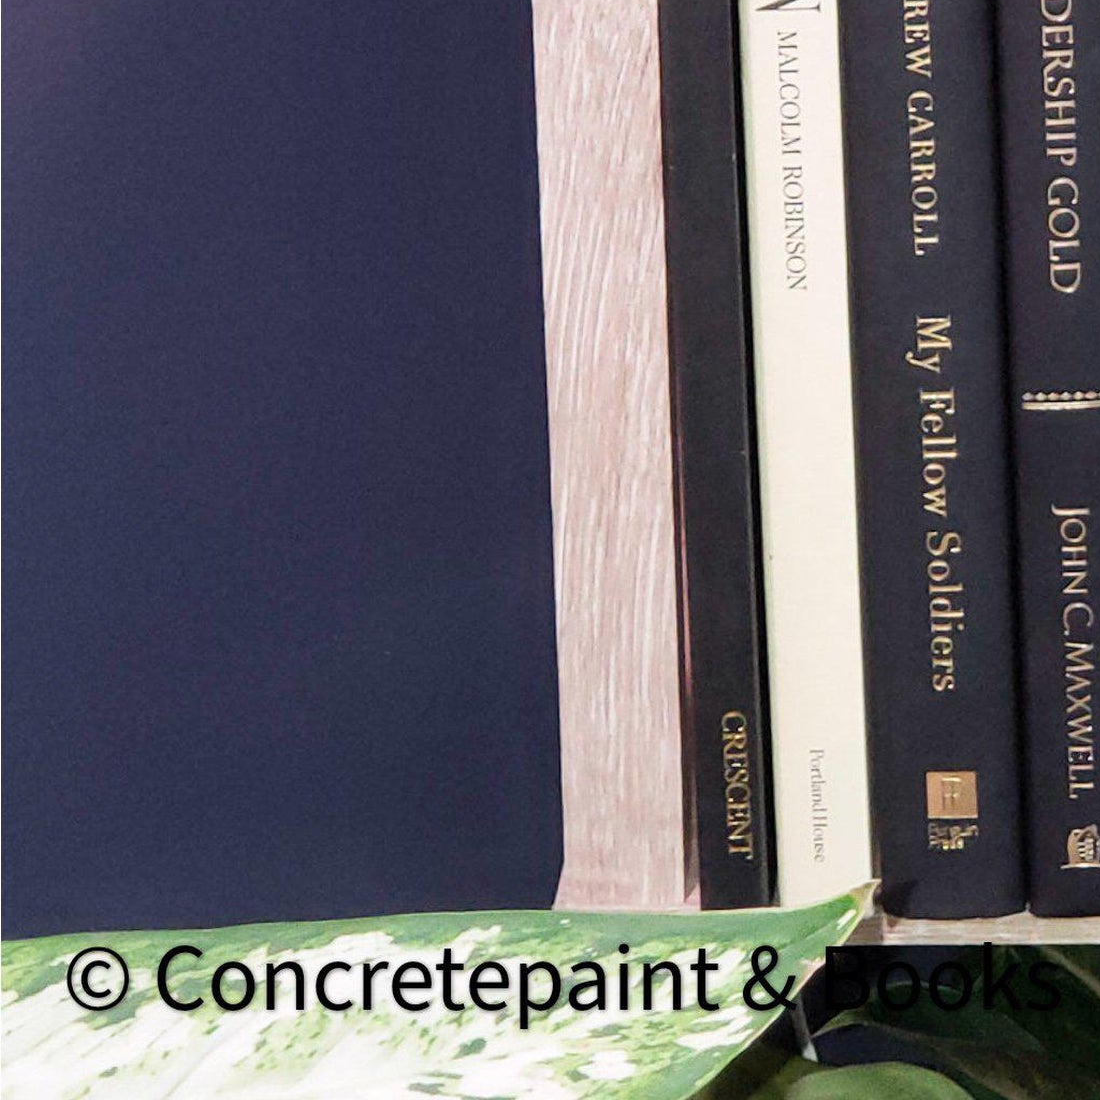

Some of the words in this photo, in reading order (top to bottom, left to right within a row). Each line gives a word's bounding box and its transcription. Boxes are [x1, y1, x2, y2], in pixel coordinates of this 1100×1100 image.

[776, 30, 804, 156] MALCOLM
[782, 164, 808, 291] ROBINSON
[906, 90, 940, 257] CARROLL
[1046, 176, 1082, 294] GOLD
[905, 314, 952, 374] My
[919, 387, 959, 518] Fellow
[925, 530, 965, 693] Soldiers
[1051, 504, 1091, 594] JOHN
[1062, 602, 1095, 636] C.
[809, 749, 828, 814] Portland
[1064, 642, 1095, 799] MAXWELL
[721, 710, 754, 861] CRESCENT
[812, 815, 828, 863] House
